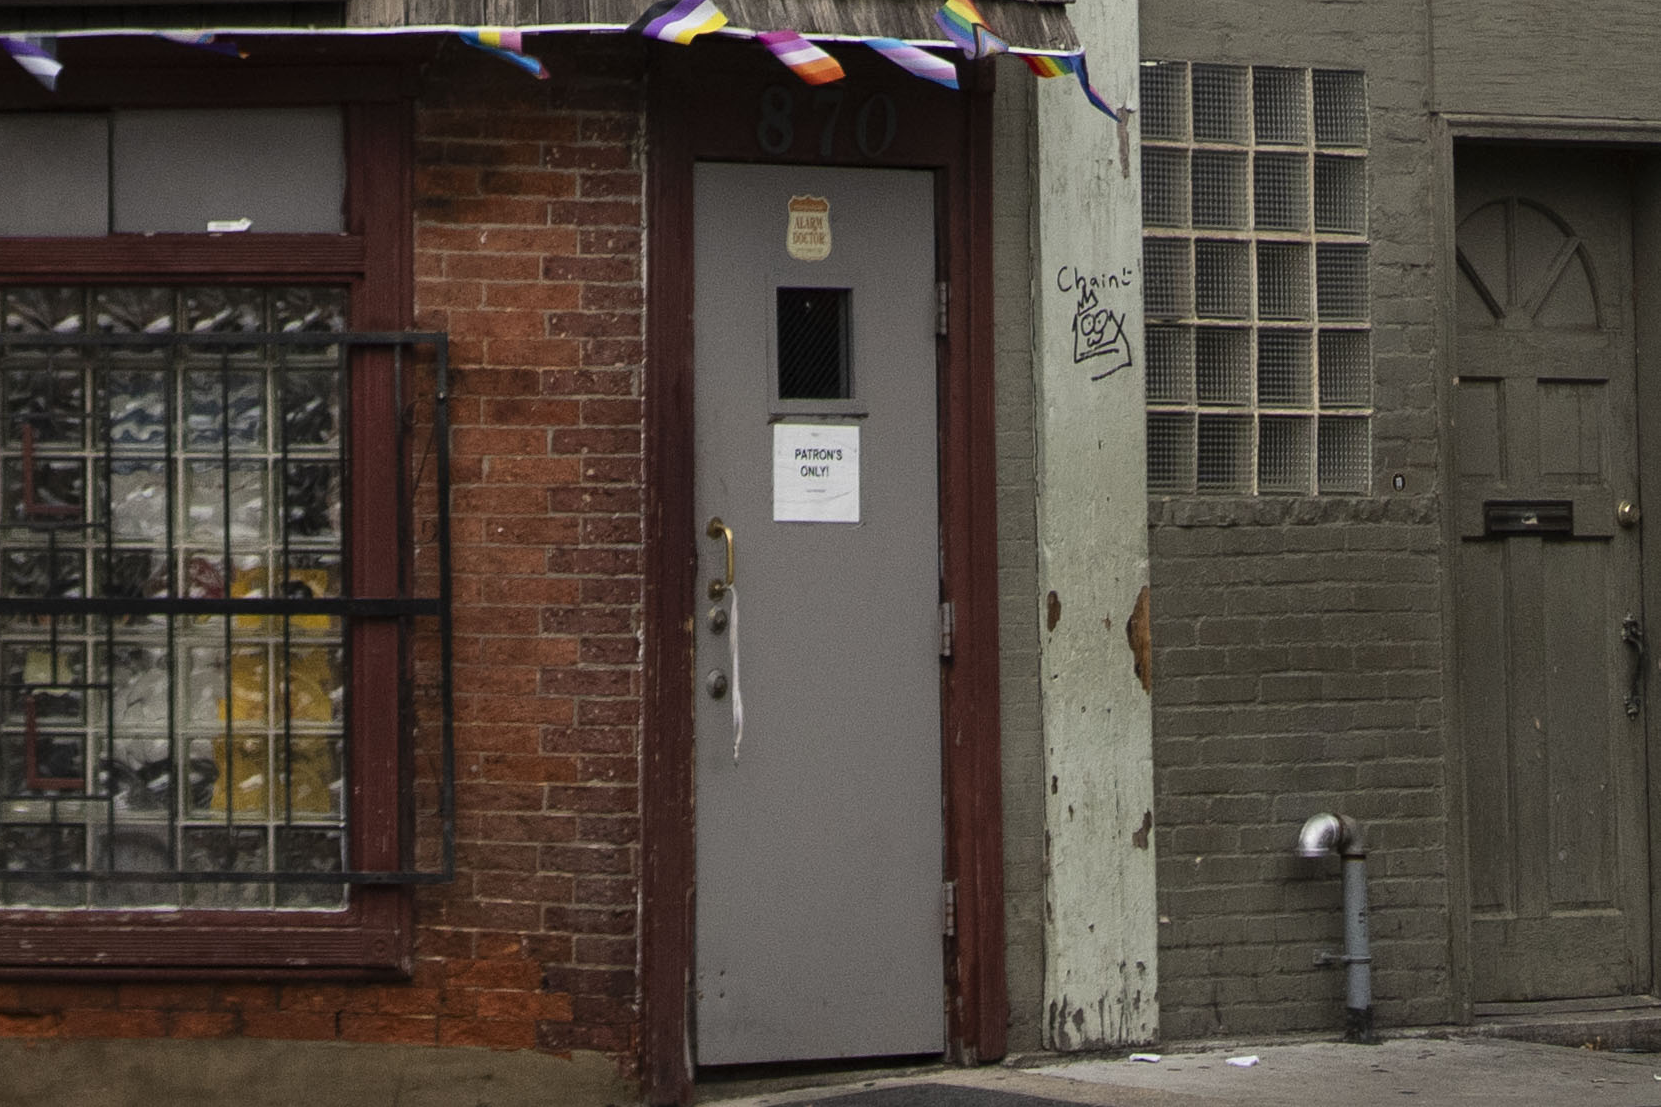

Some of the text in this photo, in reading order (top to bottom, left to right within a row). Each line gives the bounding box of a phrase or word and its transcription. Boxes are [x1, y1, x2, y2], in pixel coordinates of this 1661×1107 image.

[757, 85, 897, 158] 870
[794, 216, 824, 230] ALARM
[792, 231, 827, 245] DOCTOR
[794, 448, 843, 461] PATRON'S
[800, 465, 830, 477] ONLY!
